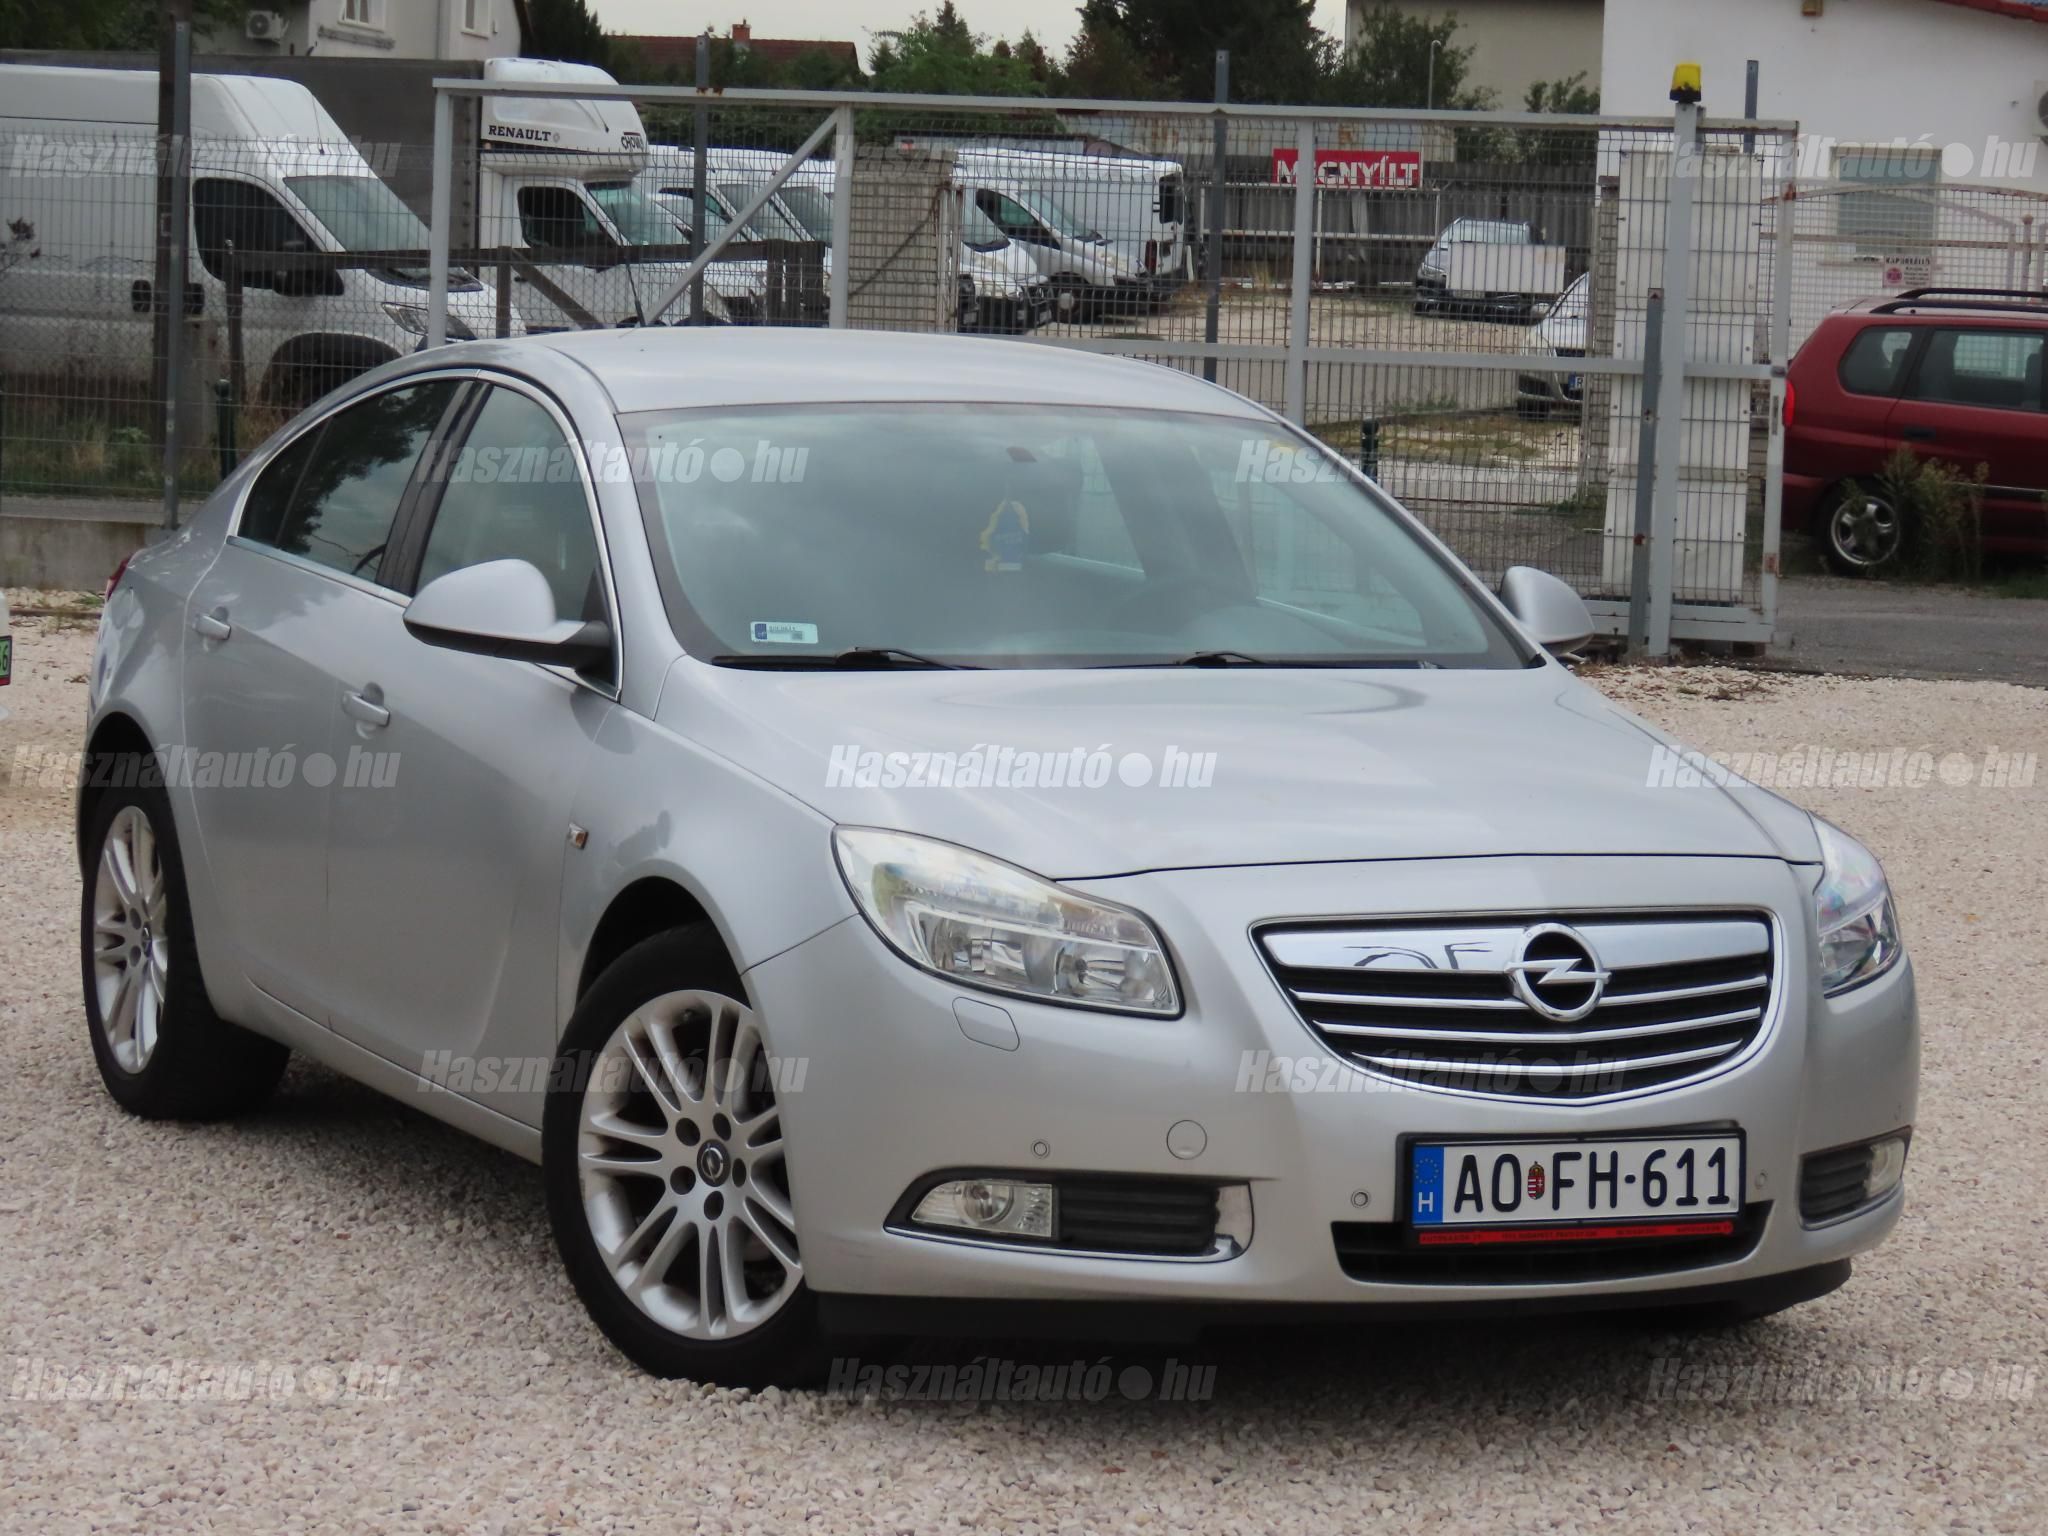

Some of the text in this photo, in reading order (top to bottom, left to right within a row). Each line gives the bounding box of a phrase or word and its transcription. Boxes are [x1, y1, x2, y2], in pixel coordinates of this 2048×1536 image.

[488, 125, 551, 142] RENAULT
[1277, 155, 1418, 186] MGNYÍLT
[1454, 1146, 1731, 1213] AO FH-611
[1418, 1191, 1434, 1213] H
